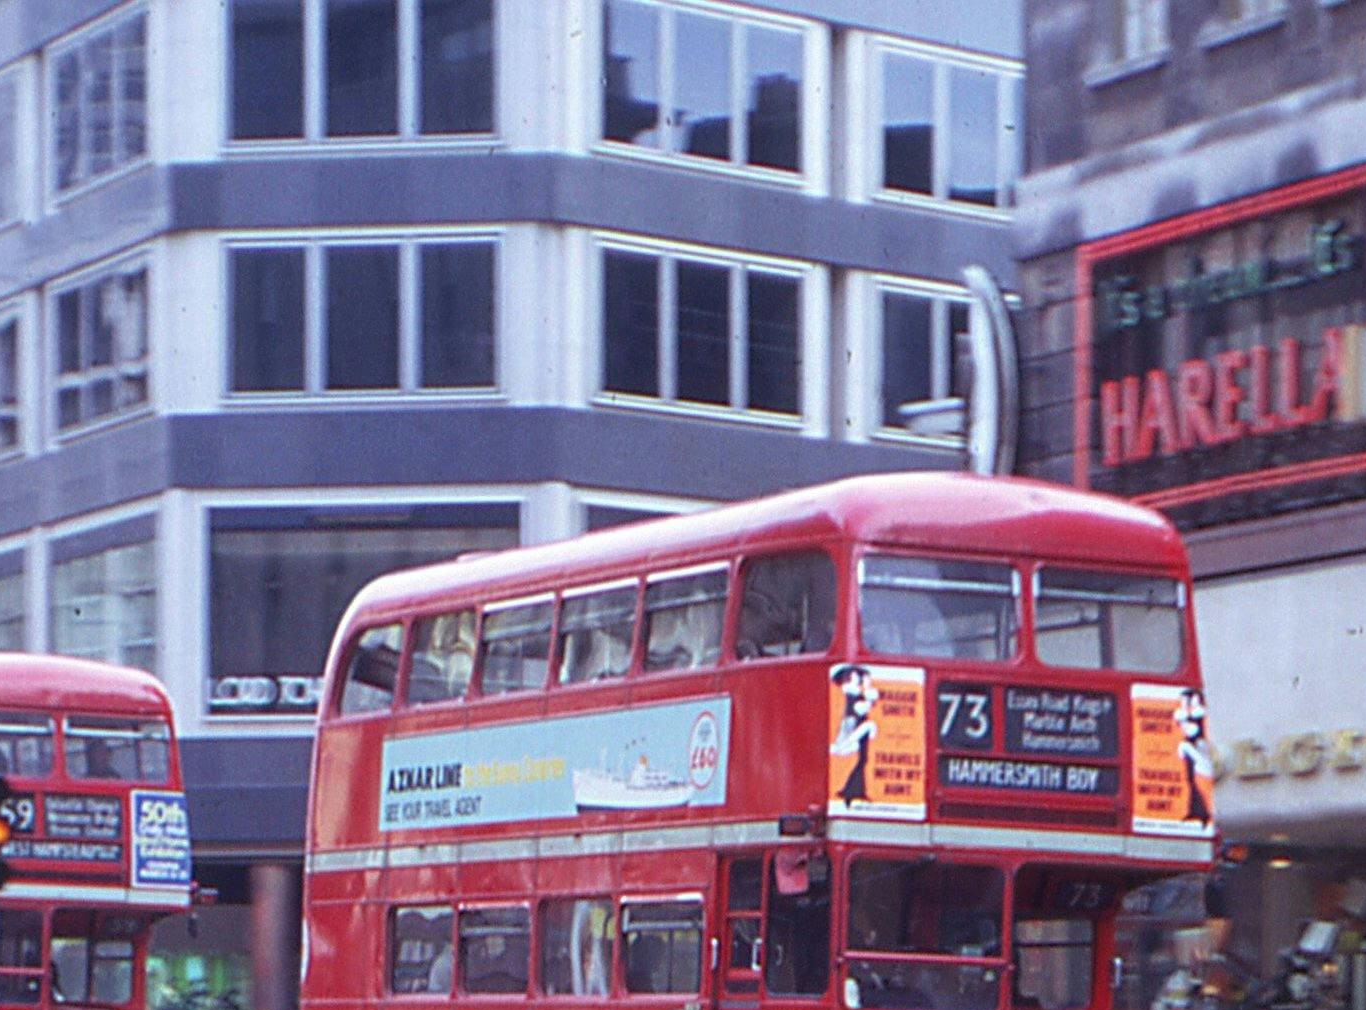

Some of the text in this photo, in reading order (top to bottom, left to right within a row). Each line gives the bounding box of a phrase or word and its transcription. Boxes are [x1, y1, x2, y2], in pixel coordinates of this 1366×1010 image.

[1100, 328, 1343, 467] HARELLA
[938, 693, 989, 738] 73
[435, 763, 463, 788] LINE
[873, 767, 922, 781] WITH MY
[948, 758, 1063, 789] HAMMERSMITH
[140, 800, 187, 823] 50th
